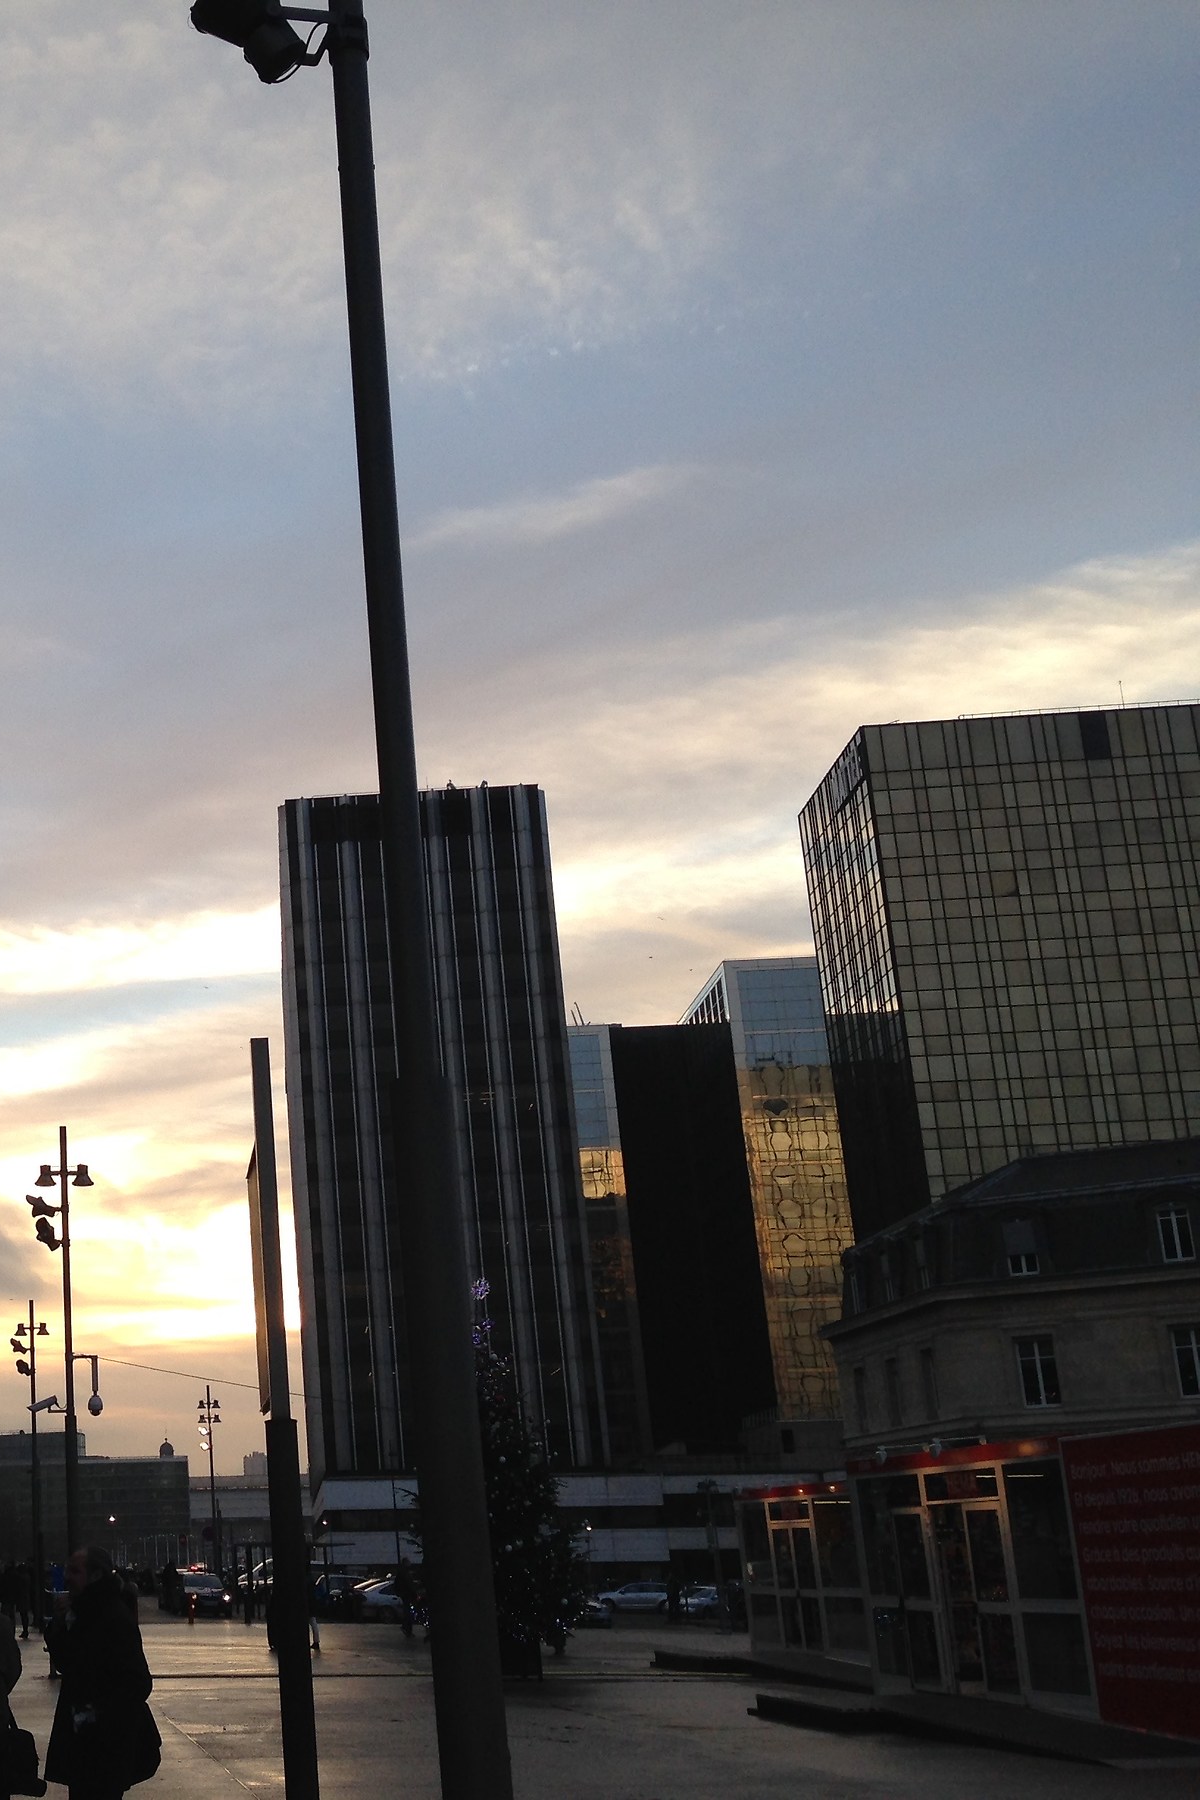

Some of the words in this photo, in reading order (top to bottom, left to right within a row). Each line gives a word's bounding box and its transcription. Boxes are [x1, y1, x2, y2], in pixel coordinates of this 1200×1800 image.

[1110, 1460, 1137, 1476] Nous
[1137, 1457, 1181, 1473] sommes
[1084, 1489, 1116, 1511] depuis
[1143, 1488, 1169, 1503] nous
[1112, 1518, 1138, 1534] votre
[1139, 1513, 1190, 1537] quotidien
[1122, 1544, 1141, 1562] des
[1142, 1543, 1185, 1567] produits
[1147, 1574, 1184, 1592] Source
[1091, 1604, 1127, 1624] chaque
[1094, 1631, 1124, 1653] Soyez
